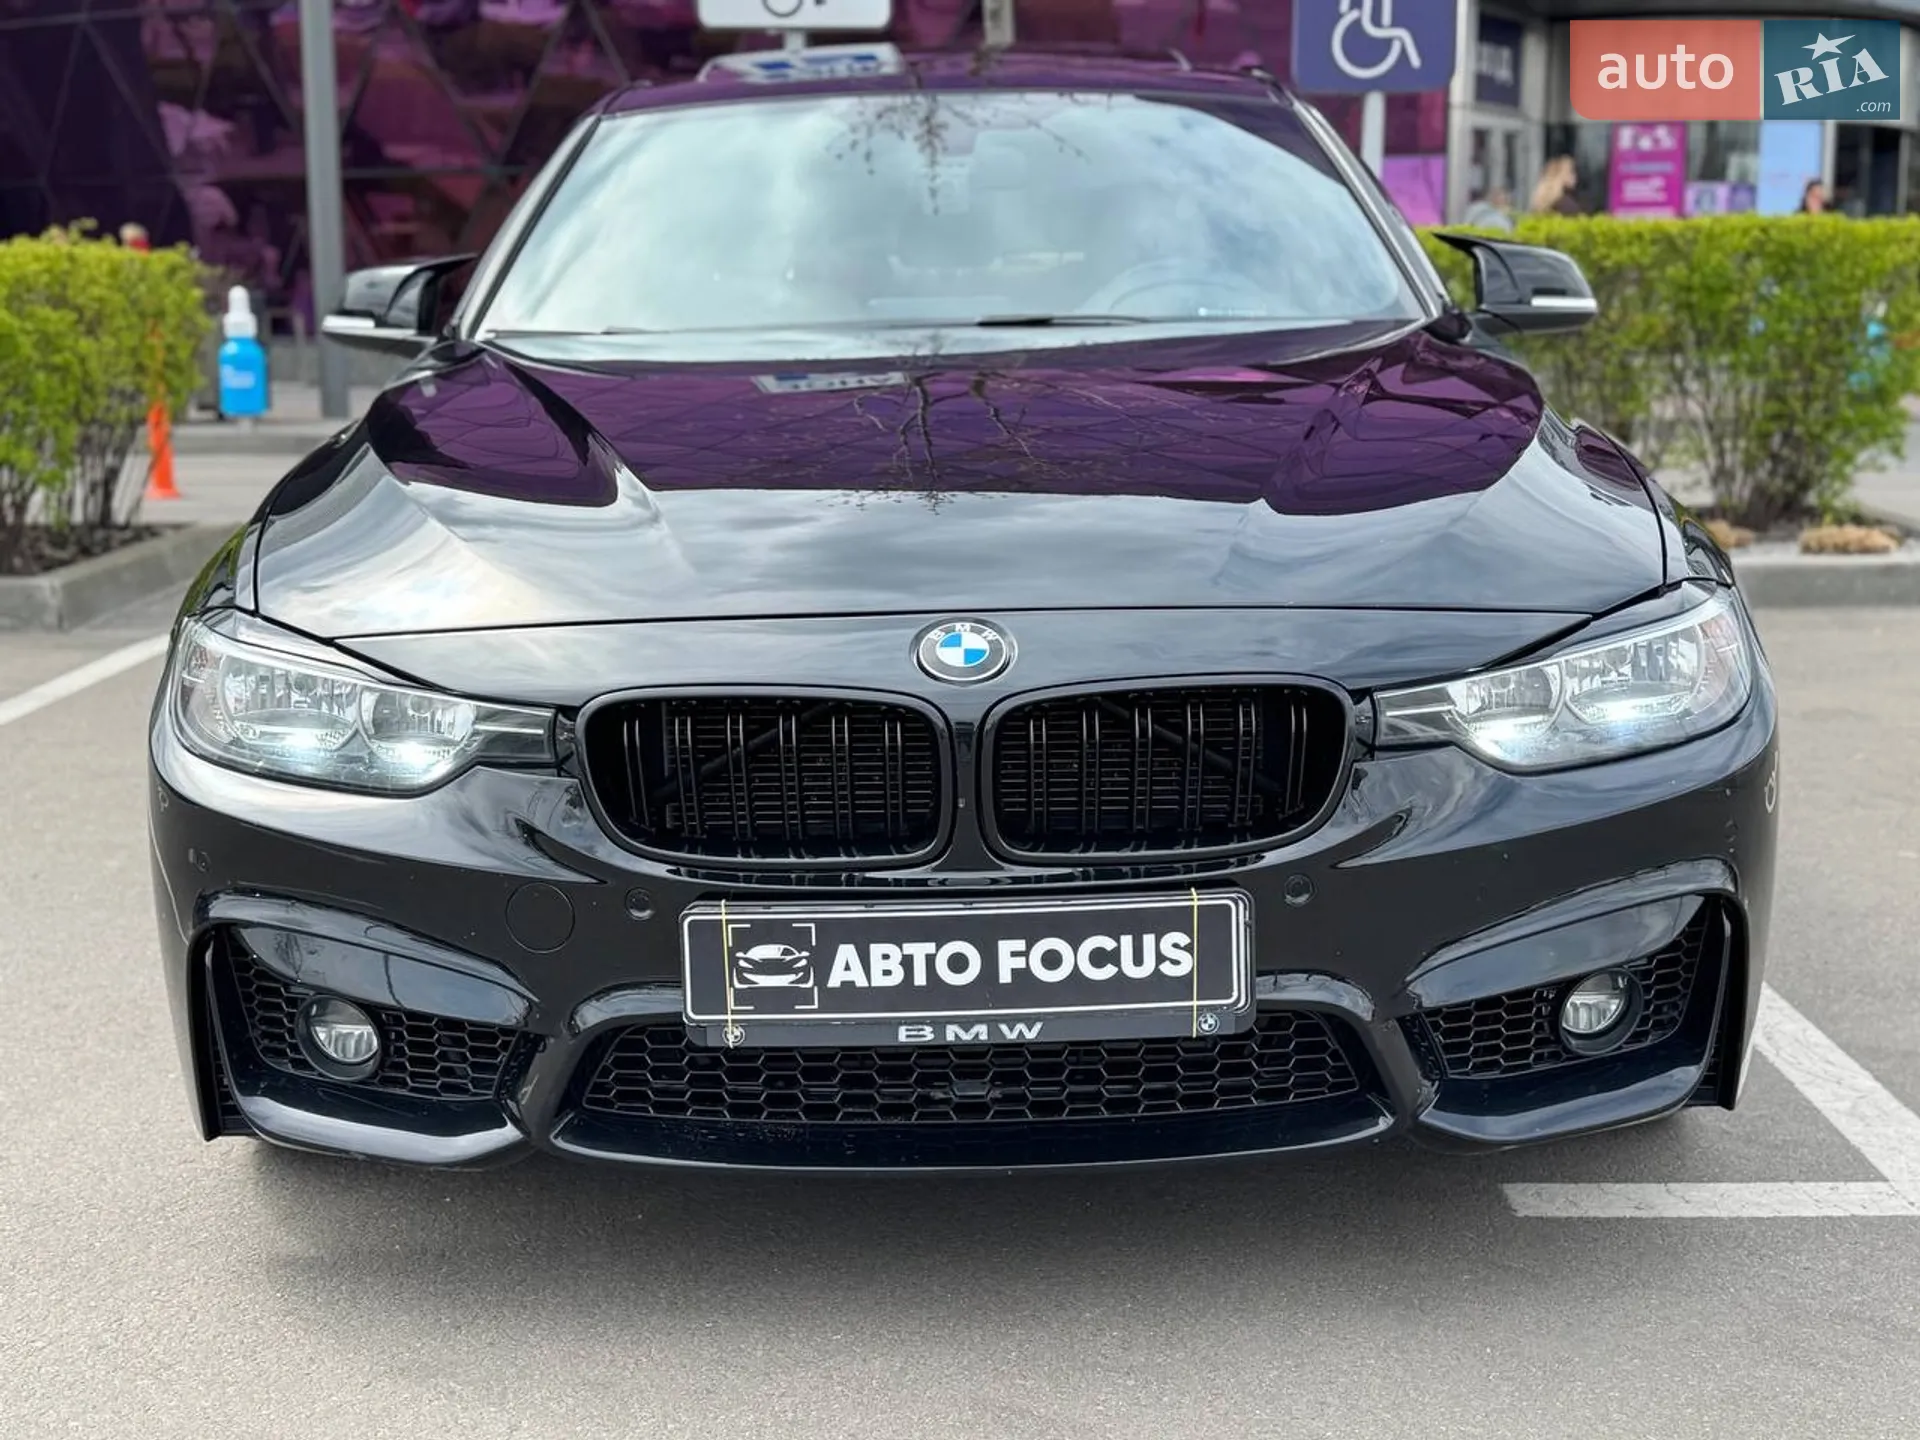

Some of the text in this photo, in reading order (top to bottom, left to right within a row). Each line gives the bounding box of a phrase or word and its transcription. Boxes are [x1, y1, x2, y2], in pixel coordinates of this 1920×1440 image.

[928, 623, 999, 641] BMW
[998, 931, 1194, 984] FOCUS
[898, 1021, 1044, 1043] BMW
